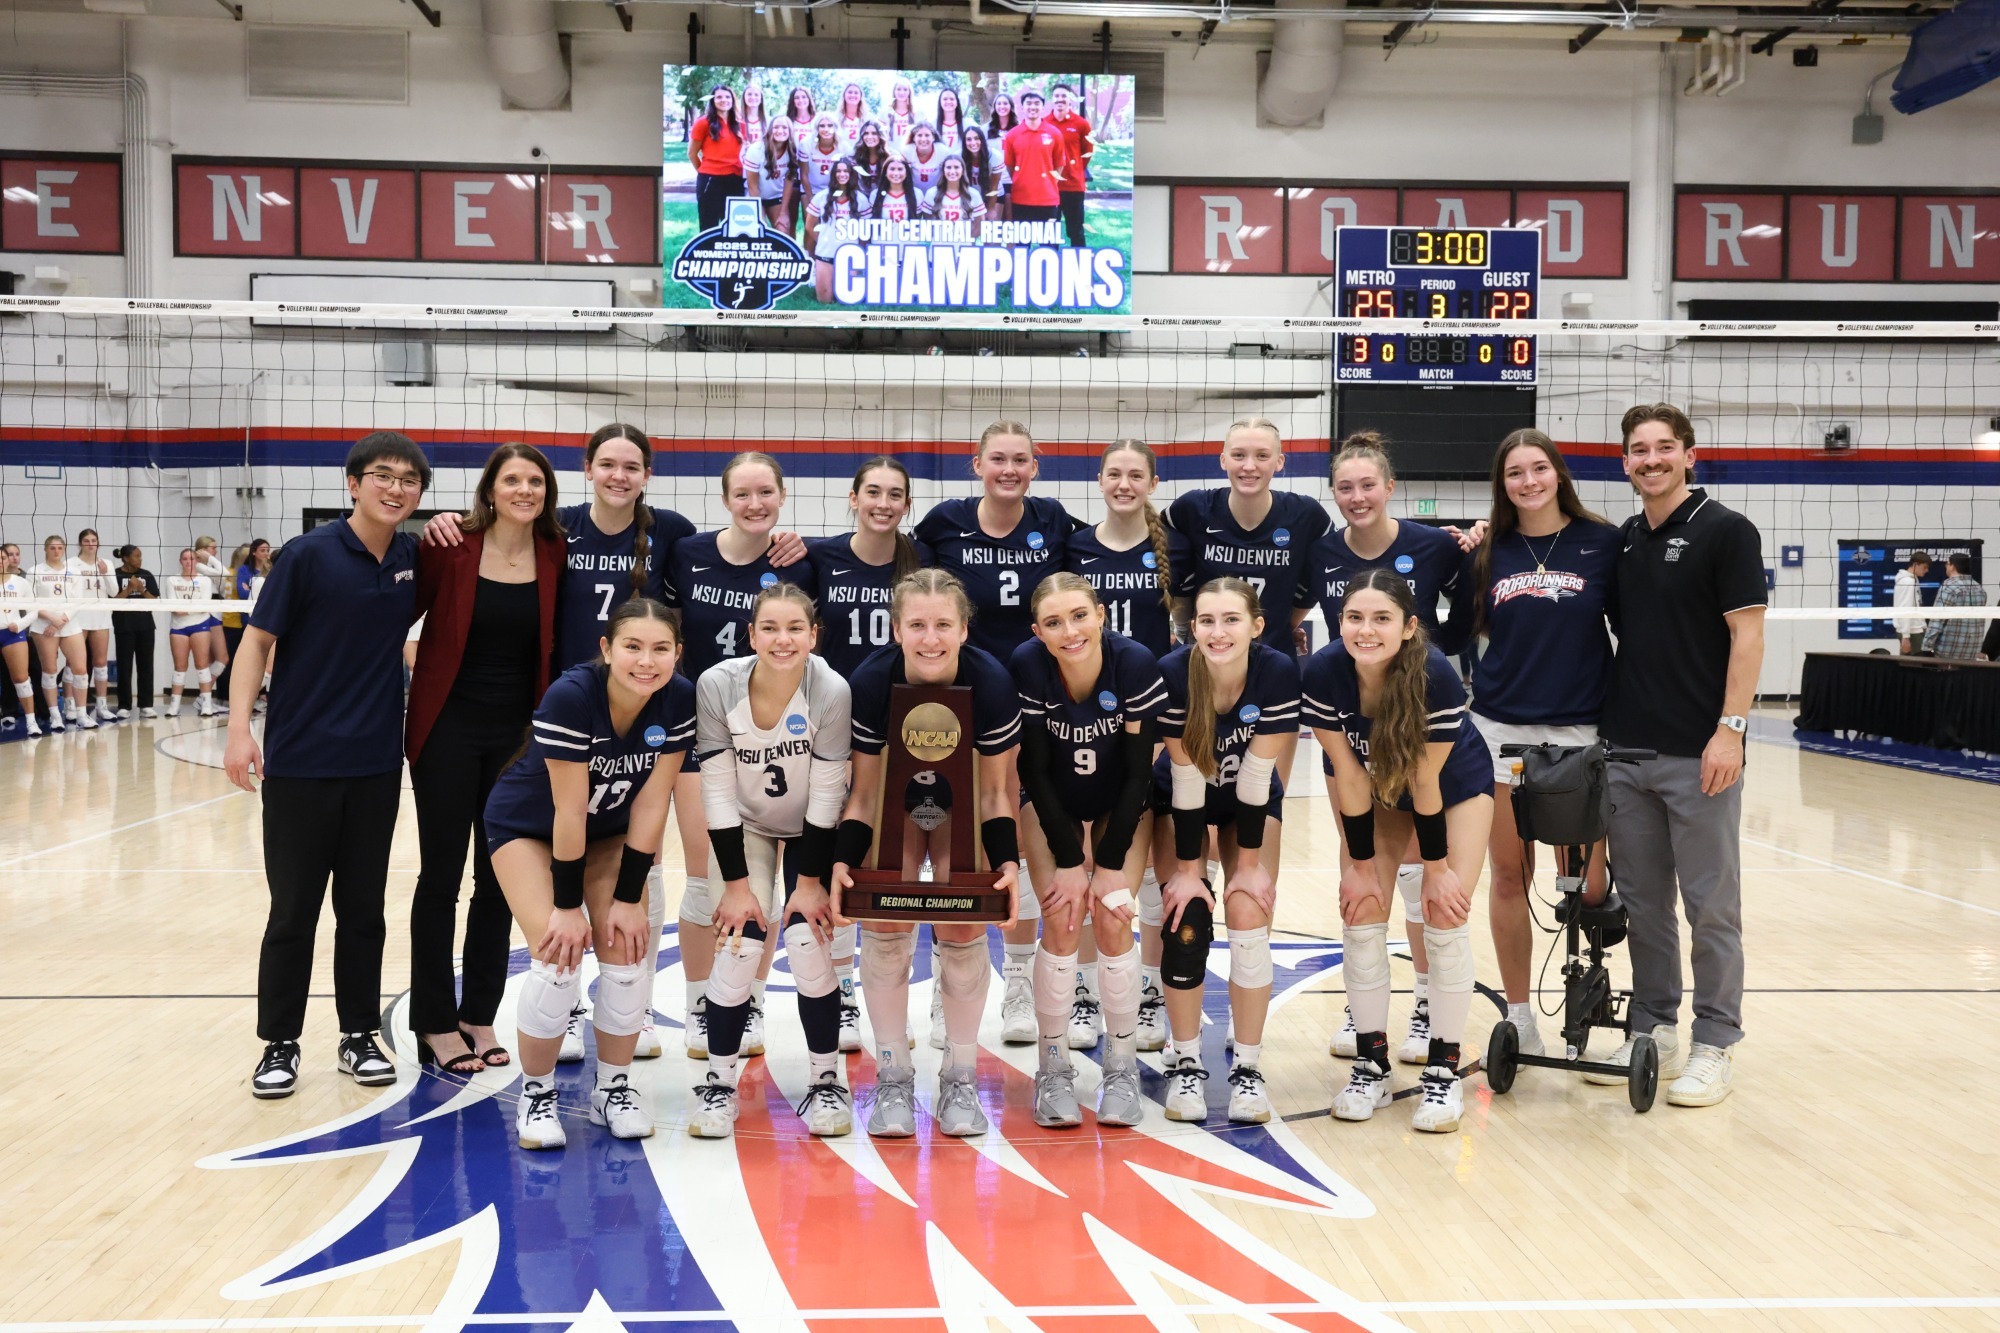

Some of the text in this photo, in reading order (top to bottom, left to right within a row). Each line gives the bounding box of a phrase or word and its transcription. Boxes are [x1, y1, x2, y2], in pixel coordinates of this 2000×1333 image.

[835, 218, 1065, 244] SOUTH CENTRAL REGIONAL
[693, 250, 793, 260] WOMEN'S VOLLEYBALL
[714, 242, 772, 251] 2025 DII
[1416, 232, 1484, 265] 3:00
[677, 260, 809, 280] CHAMPIONSHIP
[834, 244, 1124, 307] CHAMPIONS
[1346, 270, 1395, 286] METRO
[1482, 271, 1530, 287] GUEST
[1420, 279, 1456, 290] PERIOD
[1355, 290, 1395, 318] 25
[1432, 294, 1446, 319] 3
[1490, 291, 1530, 319] 22
[1354, 338, 1367, 362] 3
[1382, 344, 1394, 362] 0
[1479, 344, 1491, 363] 0
[1513, 339, 1529, 364] 0
[1340, 368, 1372, 379] SCORE
[1419, 369, 1454, 379] MATCH
[1501, 370, 1533, 381] SCORE
[1418, 499, 1435, 513] EXIT
[1275, 535, 1290, 543] NCAA
[567, 553, 652, 571] MSU DENVR
[962, 548, 1049, 565] MSU DENVER
[1204, 544, 1290, 566] MSU DENVER
[53, 583, 62, 595] 8
[86, 578, 101, 590] 14
[998, 570, 1020, 606] 2
[1492, 574, 1584, 606] ROADRUNNERS
[594, 583, 616, 621] 7
[691, 583, 722, 605] MSU
[828, 586, 857, 603] MSU
[849, 608, 891, 646] 10
[1109, 599, 1133, 637] 11
[715, 621, 737, 656] 4
[1100, 699, 1117, 707] NCAA
[1243, 711, 1260, 720] NCAA
[1073, 713, 1124, 743] DENVER
[906, 729, 959, 748] NCAA
[734, 739, 811, 765] MSU DENVER
[1074, 748, 1097, 775] 9
[763, 764, 788, 798] 3
[880, 896, 974, 909] REGIONAL CHAMPION
